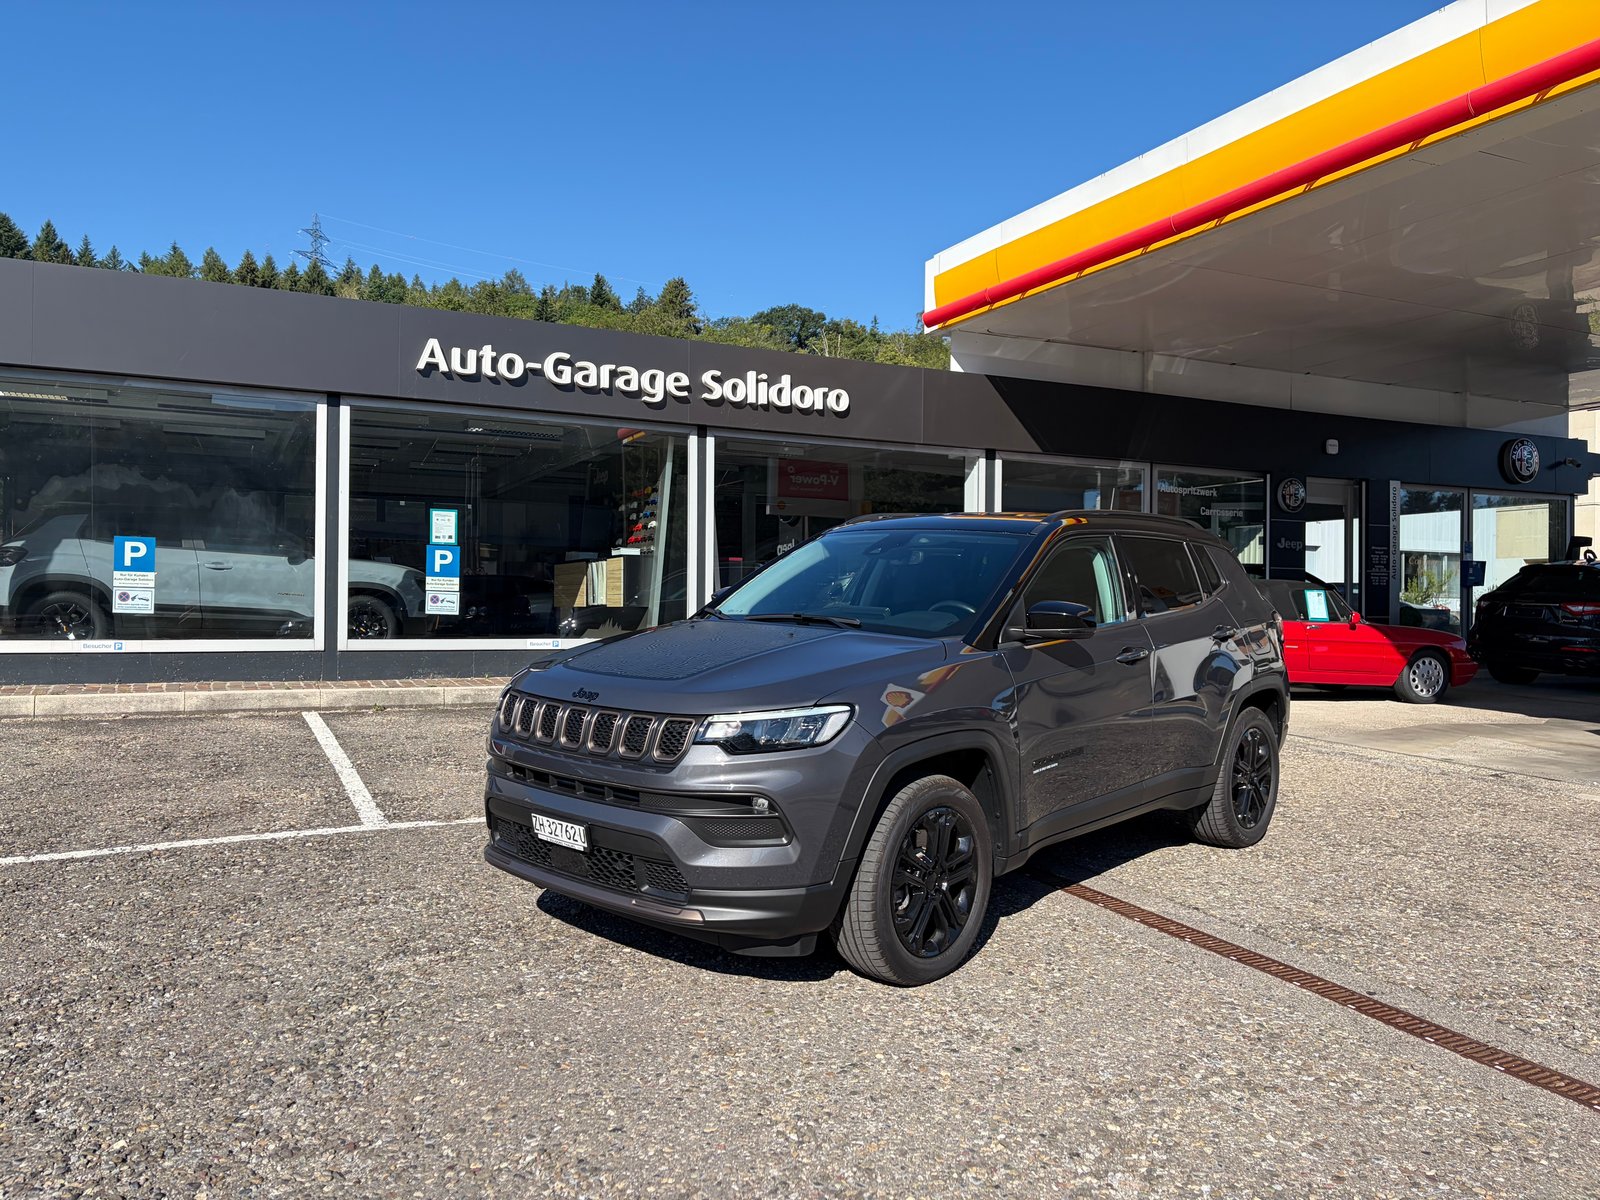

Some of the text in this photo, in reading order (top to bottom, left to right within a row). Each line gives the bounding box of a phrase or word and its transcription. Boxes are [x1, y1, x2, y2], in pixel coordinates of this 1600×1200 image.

[416, 338, 850, 412] Auto-Garage Solidoro
[1160, 486, 1218, 497] Autospritzwerk
[1200, 506, 1243, 517] Carrosserie
[1277, 537, 1303, 552] Jeep
[124, 541, 147, 567] P
[434, 549, 453, 573] P
[571, 687, 600, 702] Jeep
